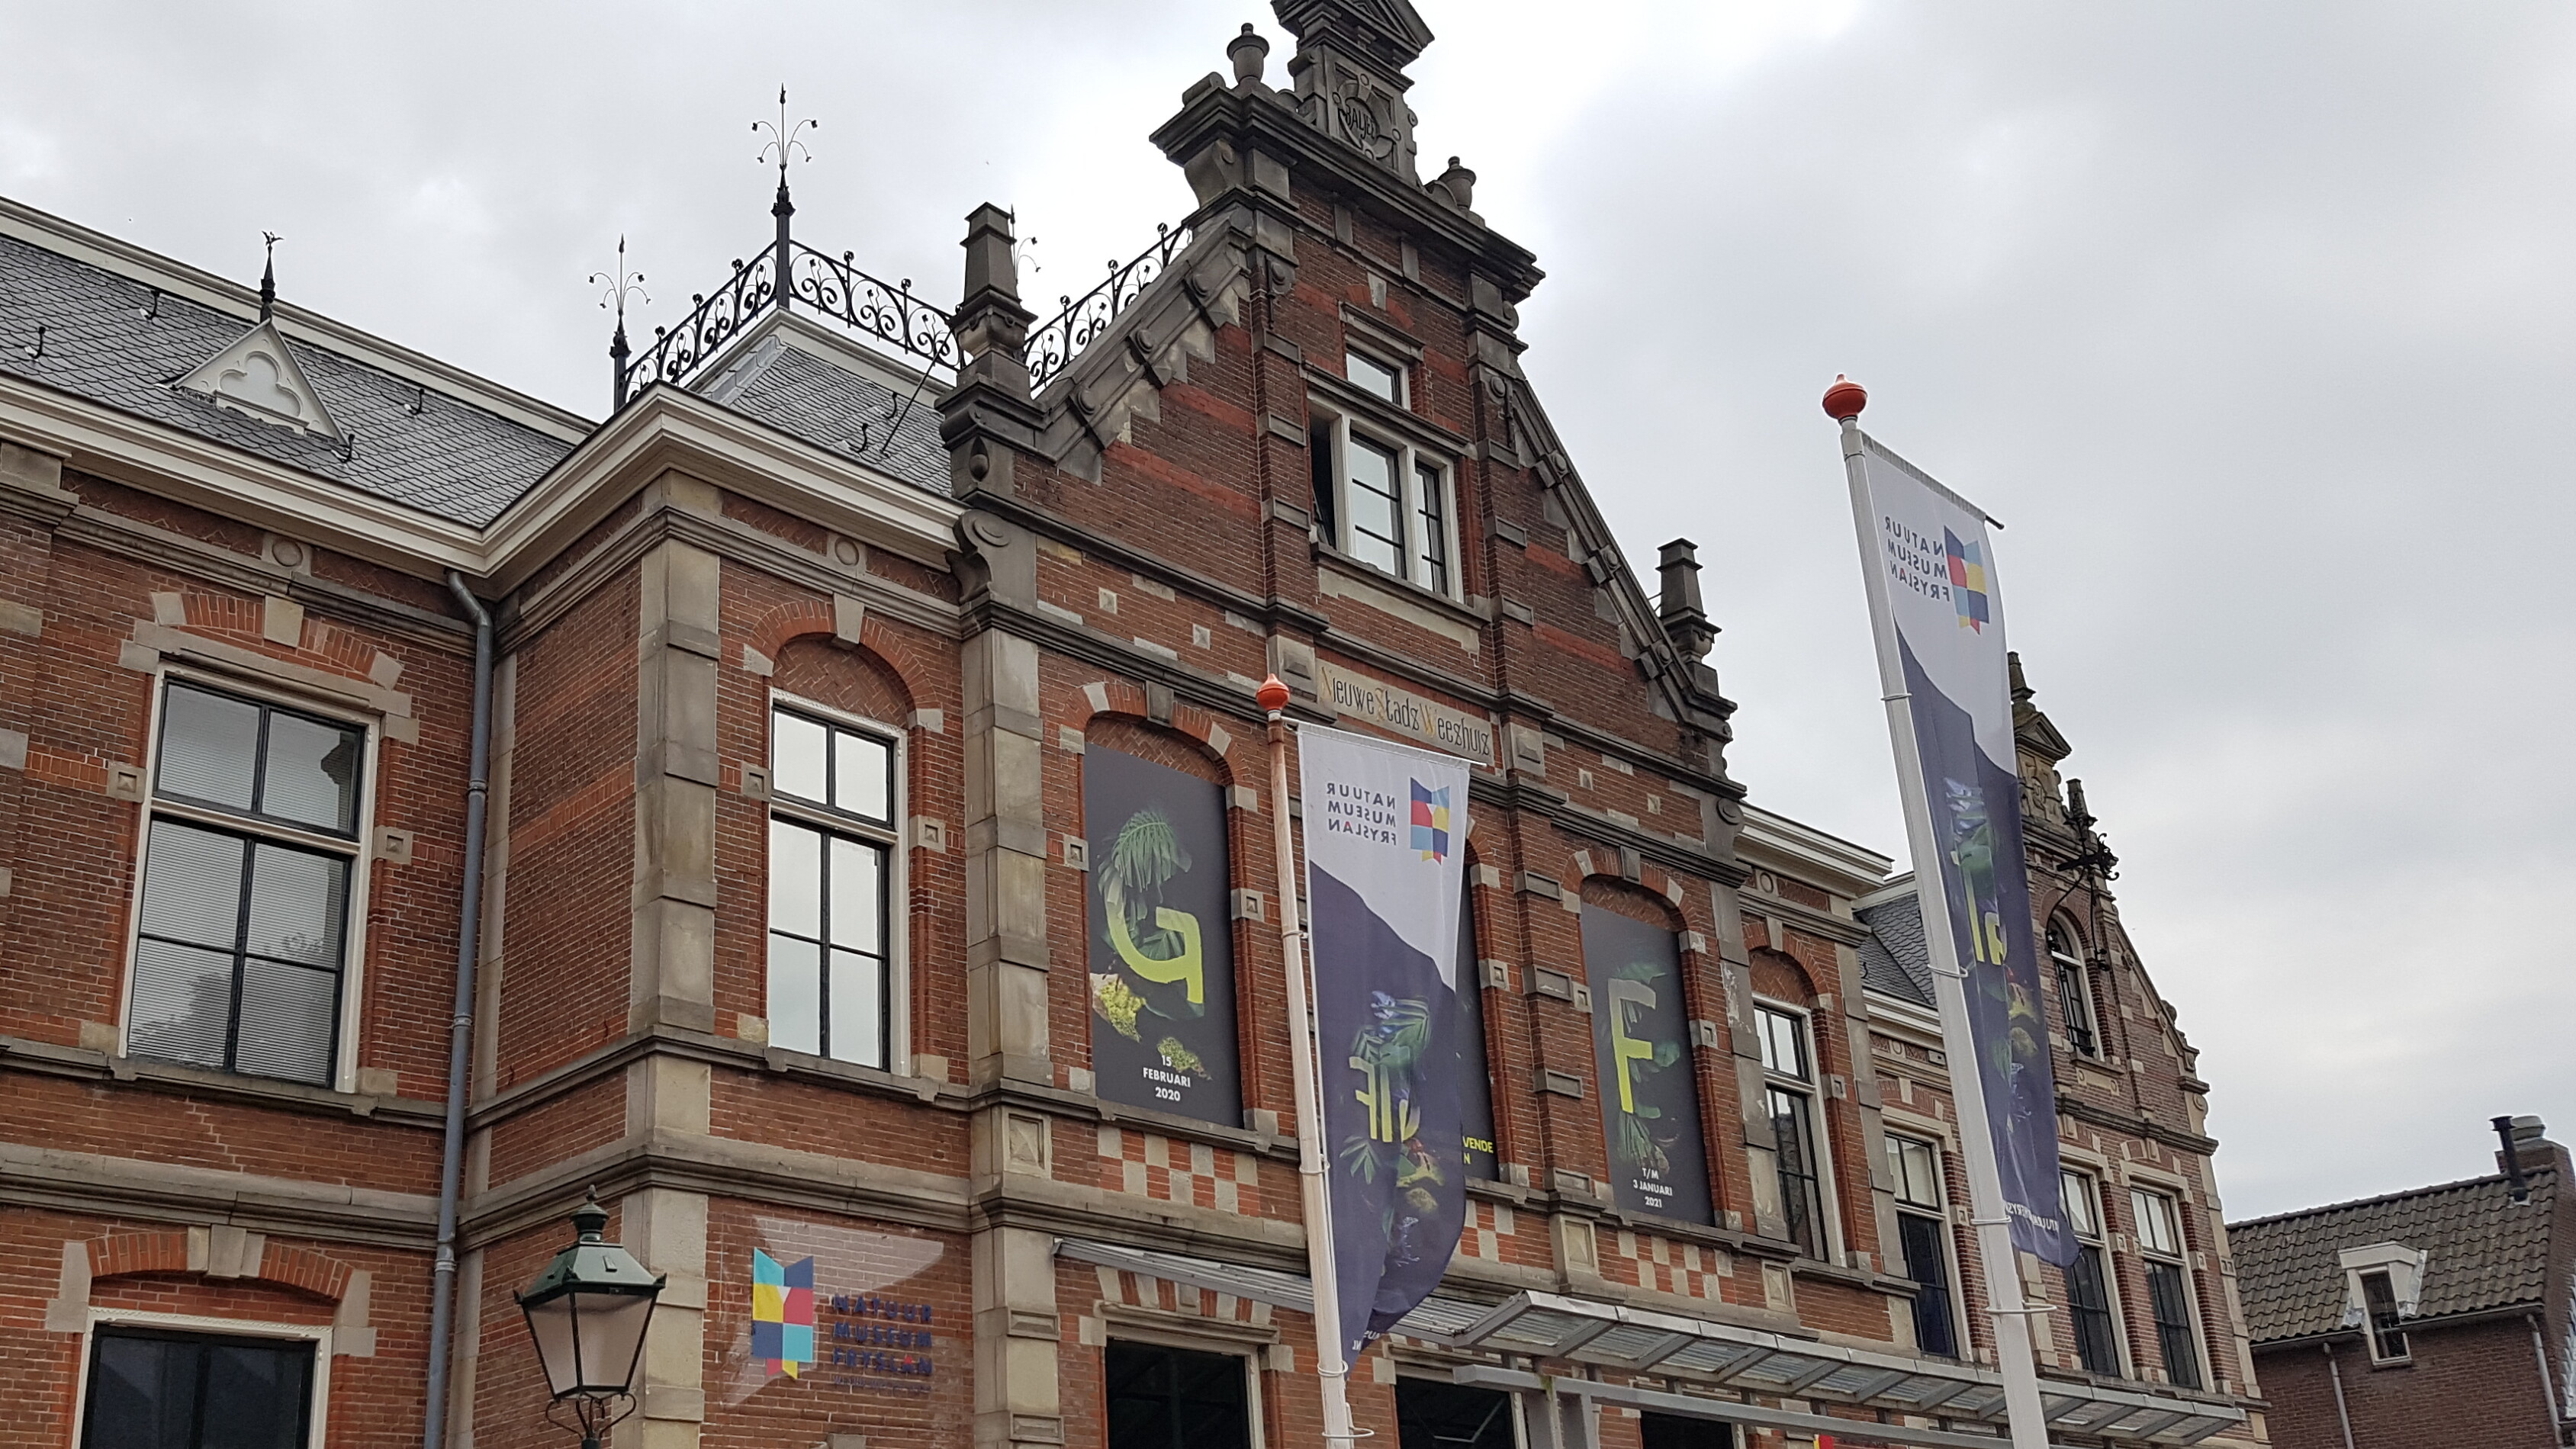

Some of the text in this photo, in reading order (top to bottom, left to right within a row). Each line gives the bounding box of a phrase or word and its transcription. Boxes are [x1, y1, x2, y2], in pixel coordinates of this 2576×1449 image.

[1420, 702, 1491, 757] Weeshuis
[1607, 977, 1657, 1114] F
[1161, 1055, 1172, 1067] 15
[1143, 1067, 1191, 1088] FEBRUARI
[1155, 1086, 1182, 1102] 2020
[1642, 1167, 1660, 1180] T/M
[1632, 1178, 1673, 1197] 3 JANUARI
[1645, 1196, 1663, 1208] 2021
